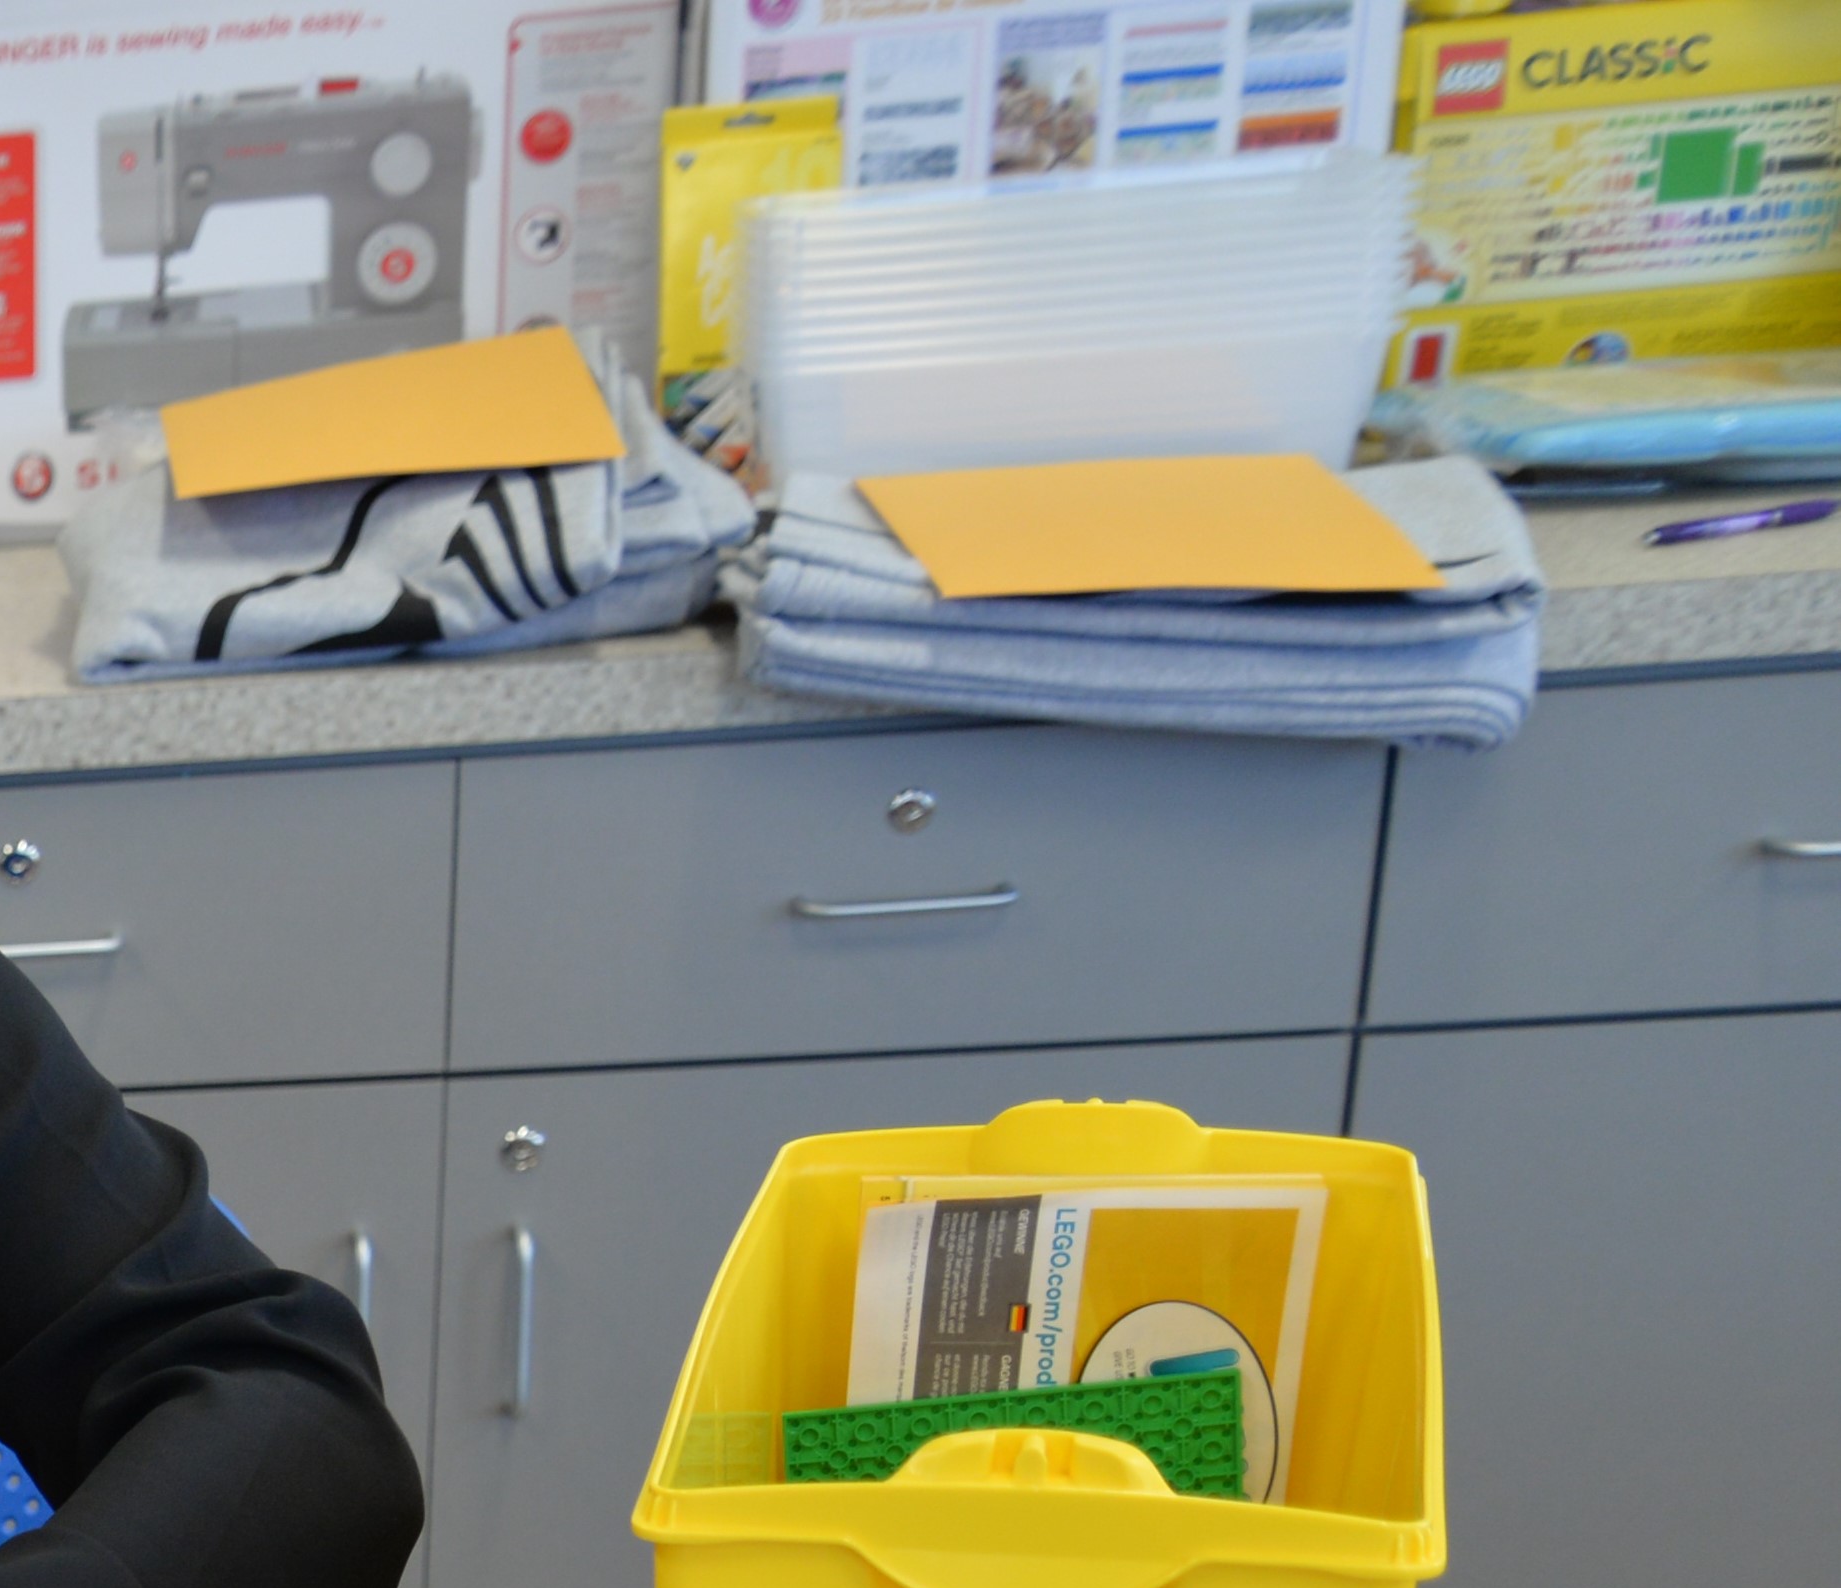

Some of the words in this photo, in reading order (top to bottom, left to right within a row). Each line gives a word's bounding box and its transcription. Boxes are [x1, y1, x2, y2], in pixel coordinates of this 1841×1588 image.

[86, 33, 107, 56] is
[117, 23, 209, 58] sewing
[216, 14, 293, 41] made
[1013, 1208, 1029, 1254] GEWINNE
